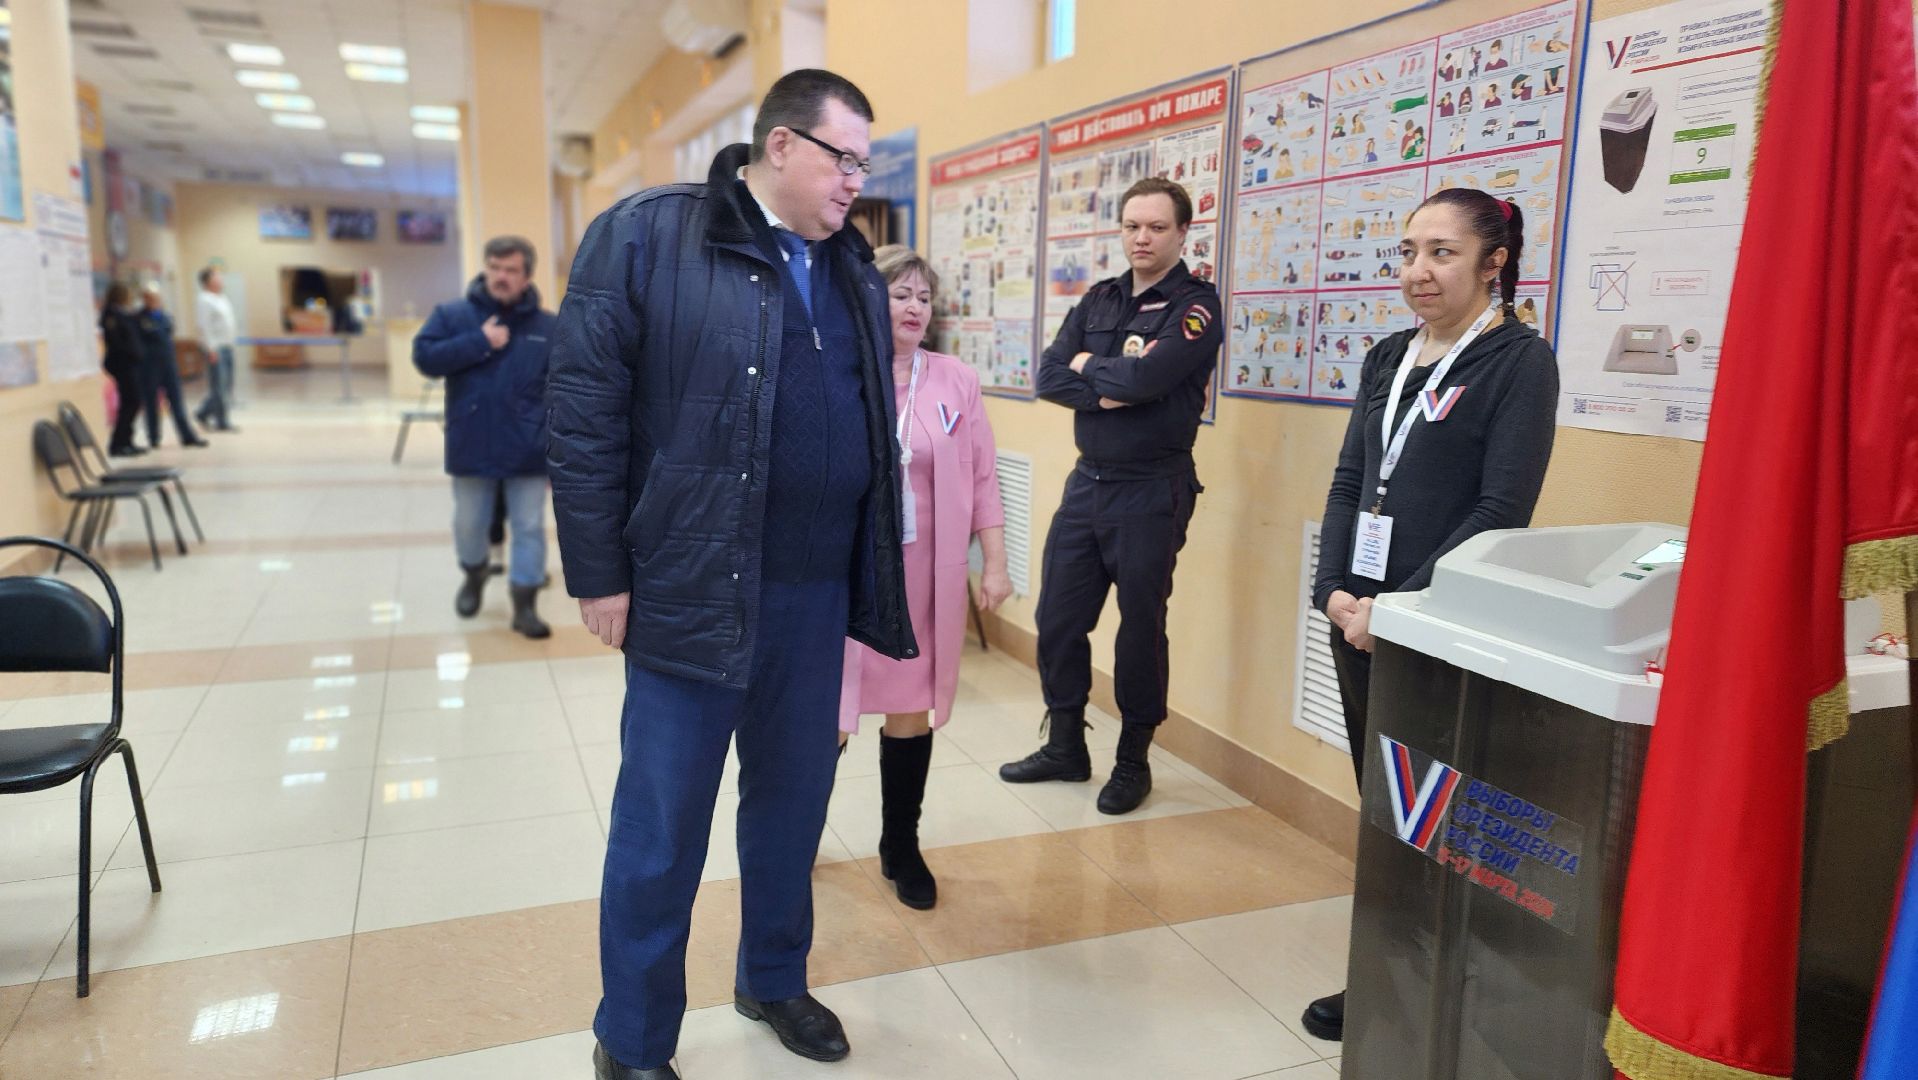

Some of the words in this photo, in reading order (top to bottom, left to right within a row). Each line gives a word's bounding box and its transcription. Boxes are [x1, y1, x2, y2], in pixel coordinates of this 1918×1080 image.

[1175, 85, 1223, 114] ПОЖАРЕ
[1697, 147, 1707, 164] 9
[1466, 780, 1556, 832] ВЫБОРЫ
[1446, 825, 1522, 875] РОССИИ
[1452, 802, 1580, 876] ПРЕЗИДЕНТА
